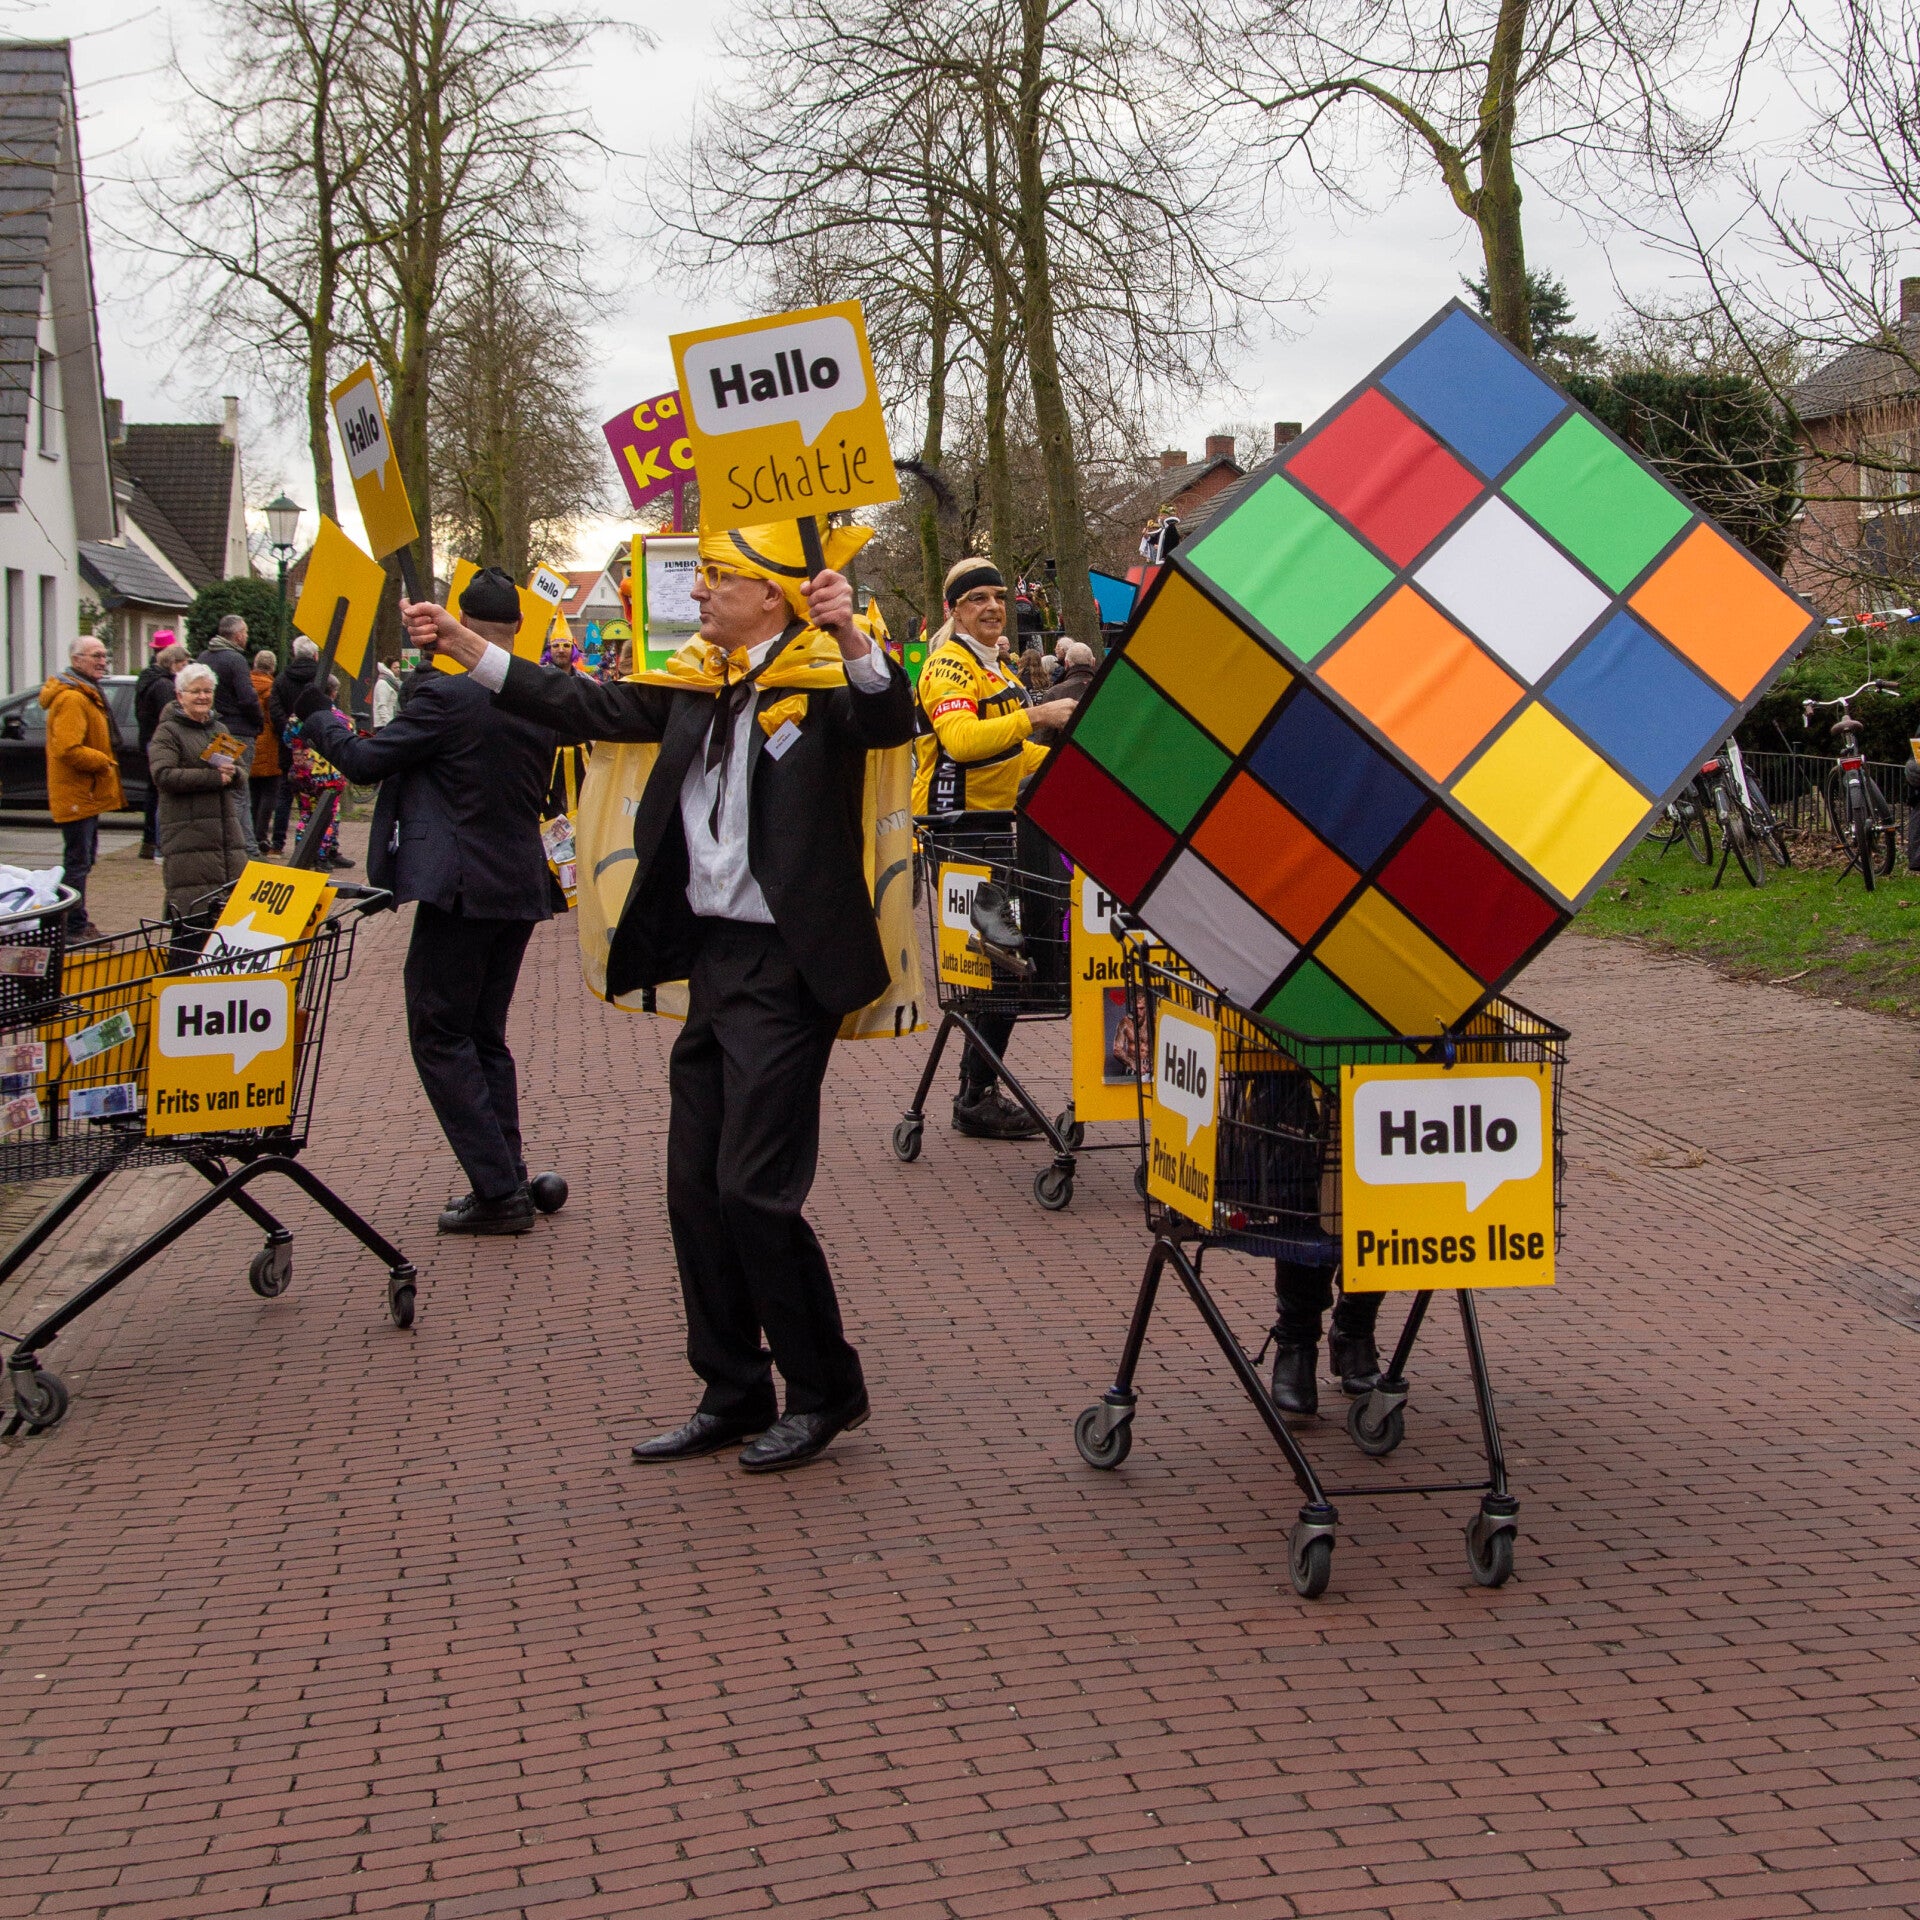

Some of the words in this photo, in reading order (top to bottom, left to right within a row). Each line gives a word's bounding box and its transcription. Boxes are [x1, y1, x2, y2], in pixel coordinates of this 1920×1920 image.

[709, 348, 840, 409] Hallo
[344, 406, 379, 457] Hallo
[664, 560, 697, 568] JUMBO
[537, 575, 559, 598] Hallo
[935, 668, 967, 689] VISMA
[935, 700, 970, 716] HEMA
[936, 762, 956, 812] HEM
[249, 879, 295, 916] Ober
[948, 888, 974, 915] Hall
[942, 950, 958, 972] Jutta
[960, 954, 991, 978] Leerdam
[177, 999, 272, 1037] Hallo
[1164, 1042, 1208, 1099] Hallo
[156, 1087, 200, 1115] Frits
[206, 1087, 239, 1111] van
[246, 1080, 286, 1107] Eerd
[1380, 1104, 1518, 1156] Hallo
[1153, 1137, 1177, 1185] Prins
[1179, 1151, 1209, 1203] Kubus
[1357, 1228, 1477, 1267] Prinses
[1488, 1224, 1545, 1261] Ilse
